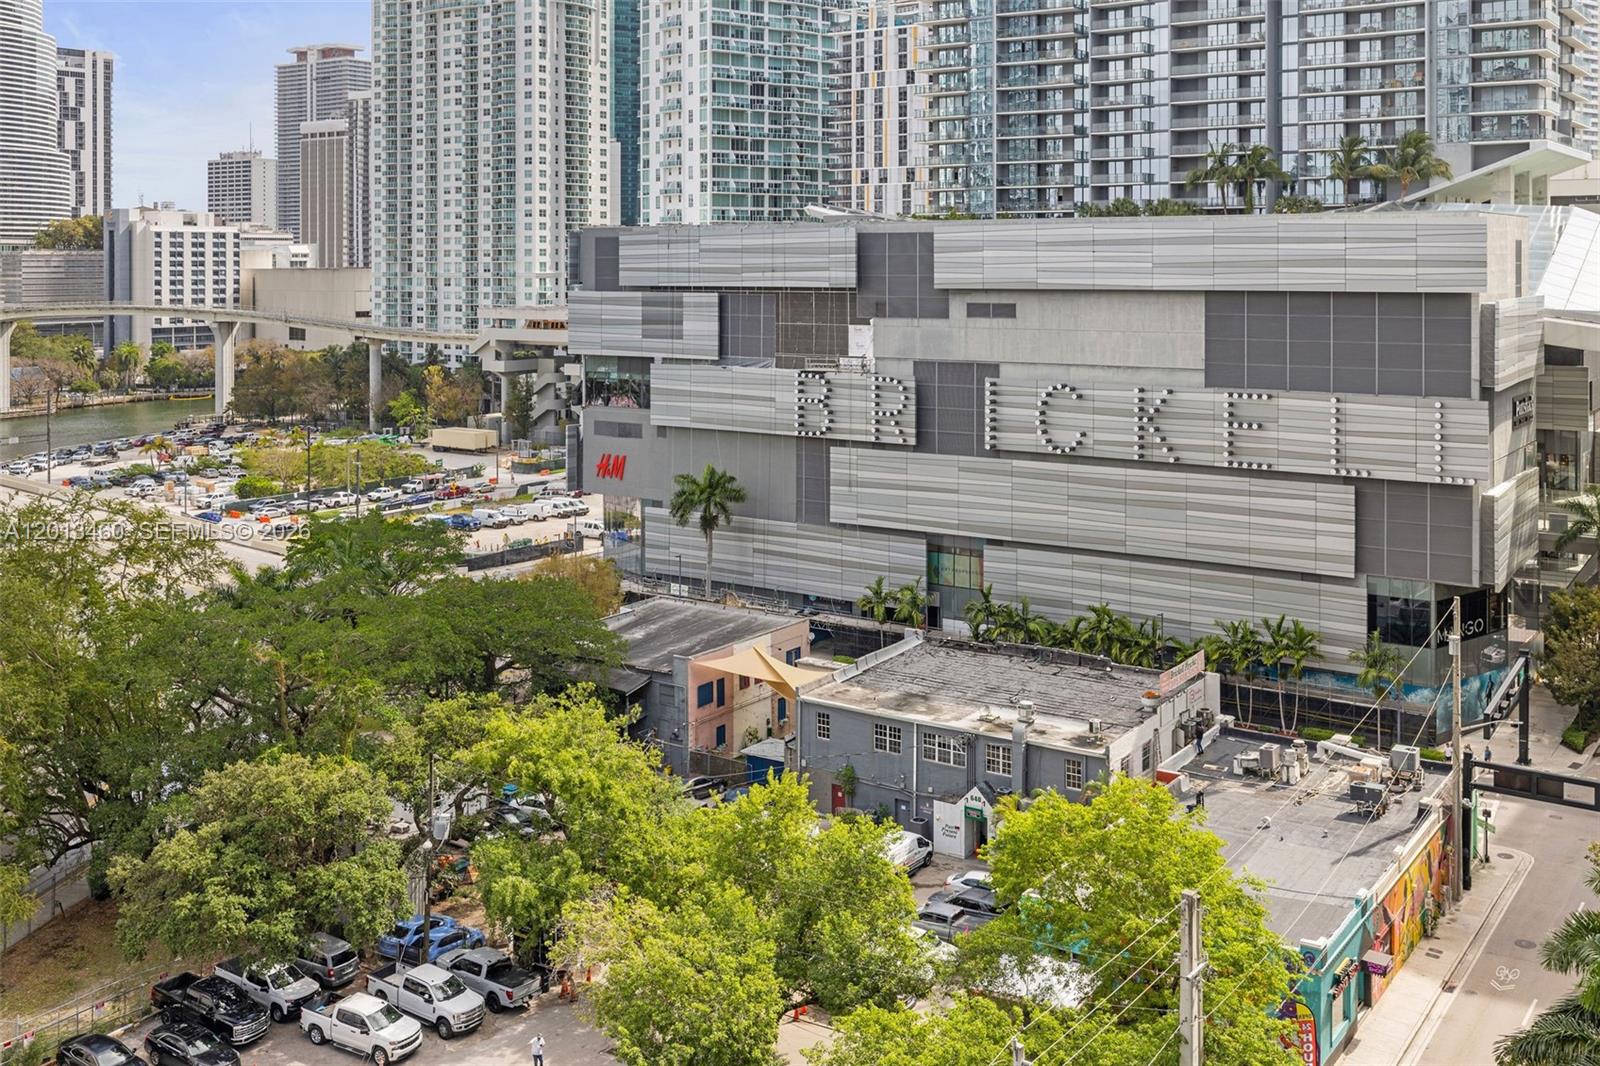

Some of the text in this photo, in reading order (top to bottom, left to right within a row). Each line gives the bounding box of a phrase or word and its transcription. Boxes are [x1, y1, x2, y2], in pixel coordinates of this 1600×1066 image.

[795, 371, 1477, 487] BRICKELL
[596, 453, 627, 480] H&M
[1437, 618, 1484, 643] MGO
